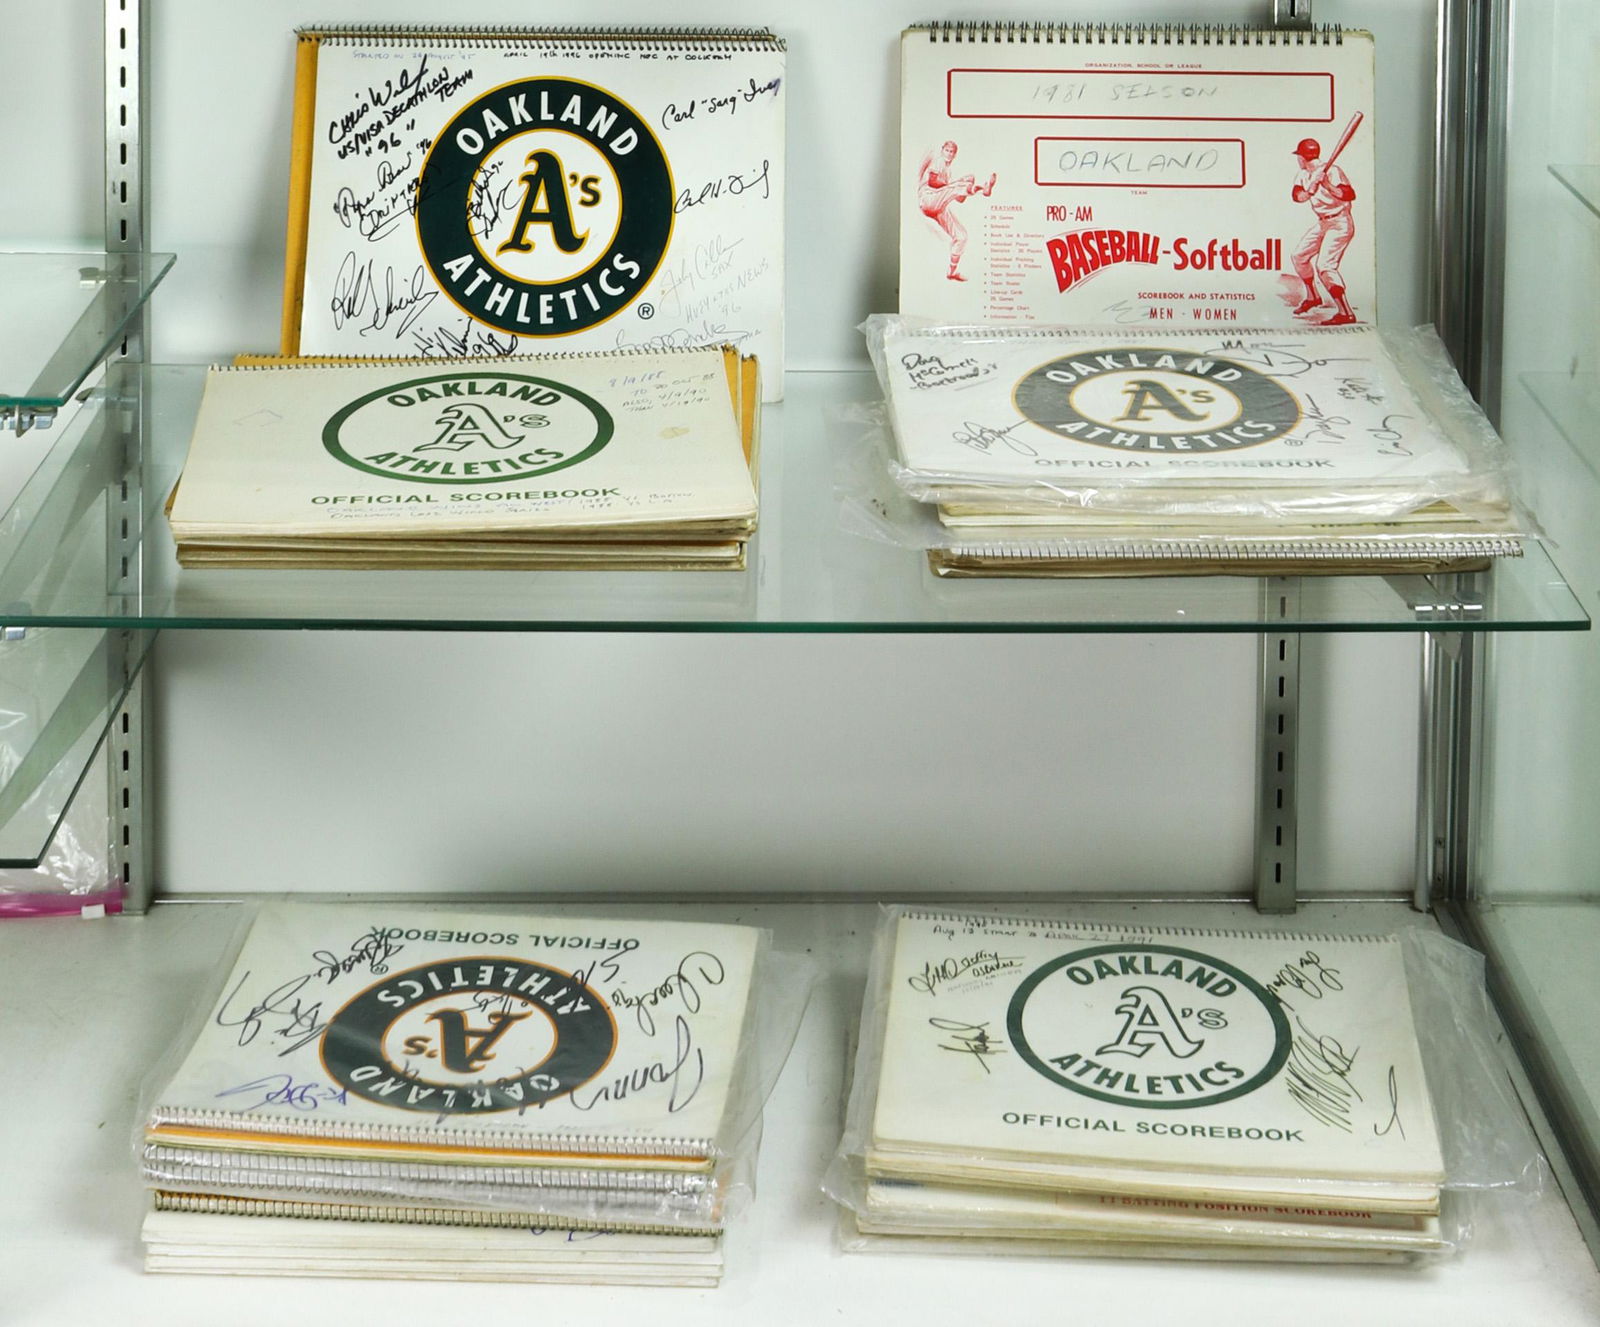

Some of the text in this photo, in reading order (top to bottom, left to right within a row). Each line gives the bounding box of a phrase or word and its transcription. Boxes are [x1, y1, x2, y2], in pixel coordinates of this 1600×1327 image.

[434, 69, 474, 103] TEAM
[1032, 82, 1088, 104] 1981
[456, 91, 639, 156] OAKLAND
[1059, 149, 1220, 174] OAKLAND
[443, 253, 641, 325] ATHLETICS
[1138, 292, 1256, 301] SCOREBOOK AND STATISTICS
[1149, 307, 1237, 321] MEN WOMEN
[1045, 353, 1243, 383] OAKLAND
[387, 381, 562, 408] OAKLAND
[1056, 419, 1277, 450] ATHLETICS
[364, 448, 565, 475] ATHLETICS
[1034, 458, 1336, 469] OFFICIAL SCOREBOOK
[311, 487, 620, 505] OFFICIAL SCOREBOOK
[369, 926, 641, 950] OFFICIAL SCOREBOOK
[376, 964, 592, 1016] ATHLETICS
[1066, 955, 1238, 998] OAKLAND
[350, 1065, 561, 1109] OAKLAND
[1049, 1052, 1246, 1095] ATHLETICS
[1002, 1112, 1305, 1143] OFFICIAL SCOREBOOK
